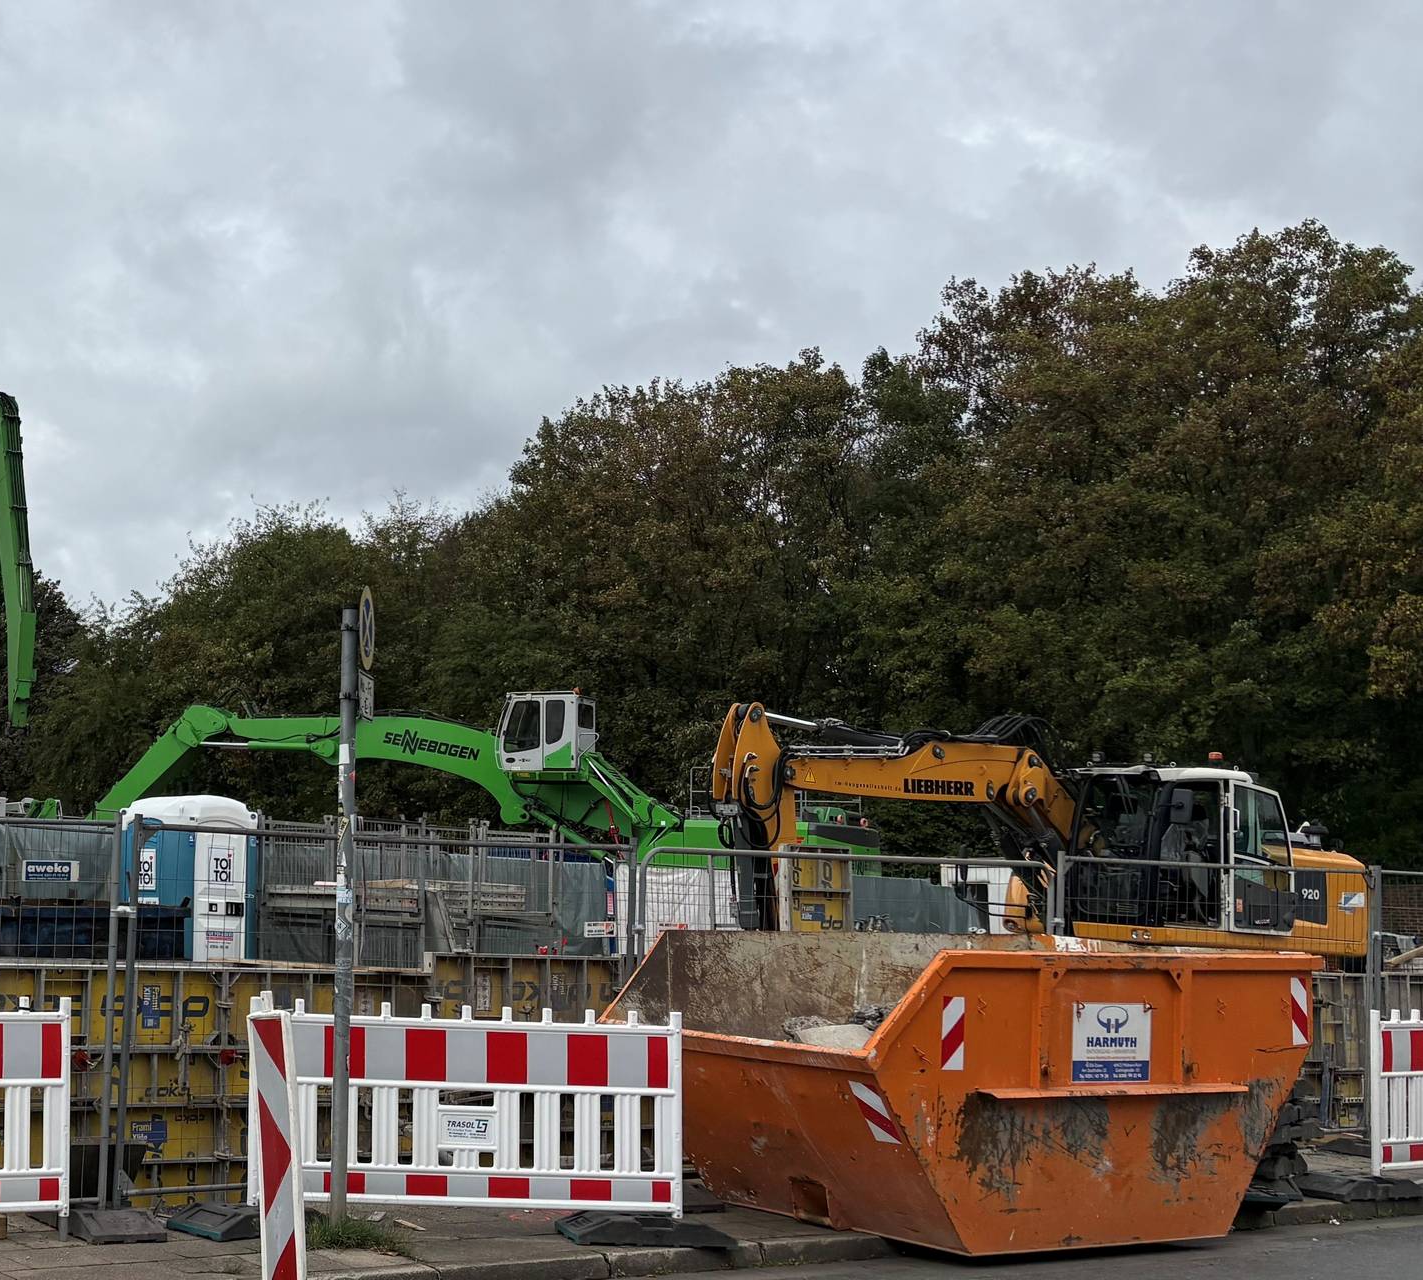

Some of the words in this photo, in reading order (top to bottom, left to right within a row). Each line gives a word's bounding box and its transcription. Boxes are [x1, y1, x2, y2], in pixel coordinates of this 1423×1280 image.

[383, 729, 480, 761] SENNEBOGEN
[903, 778, 974, 796] LIEBHERR
[27, 862, 70, 873] aweko
[1301, 888, 1320, 900] 920
[1086, 1036, 1137, 1048] HARMUTH
[447, 1120, 475, 1129] TRASOL
